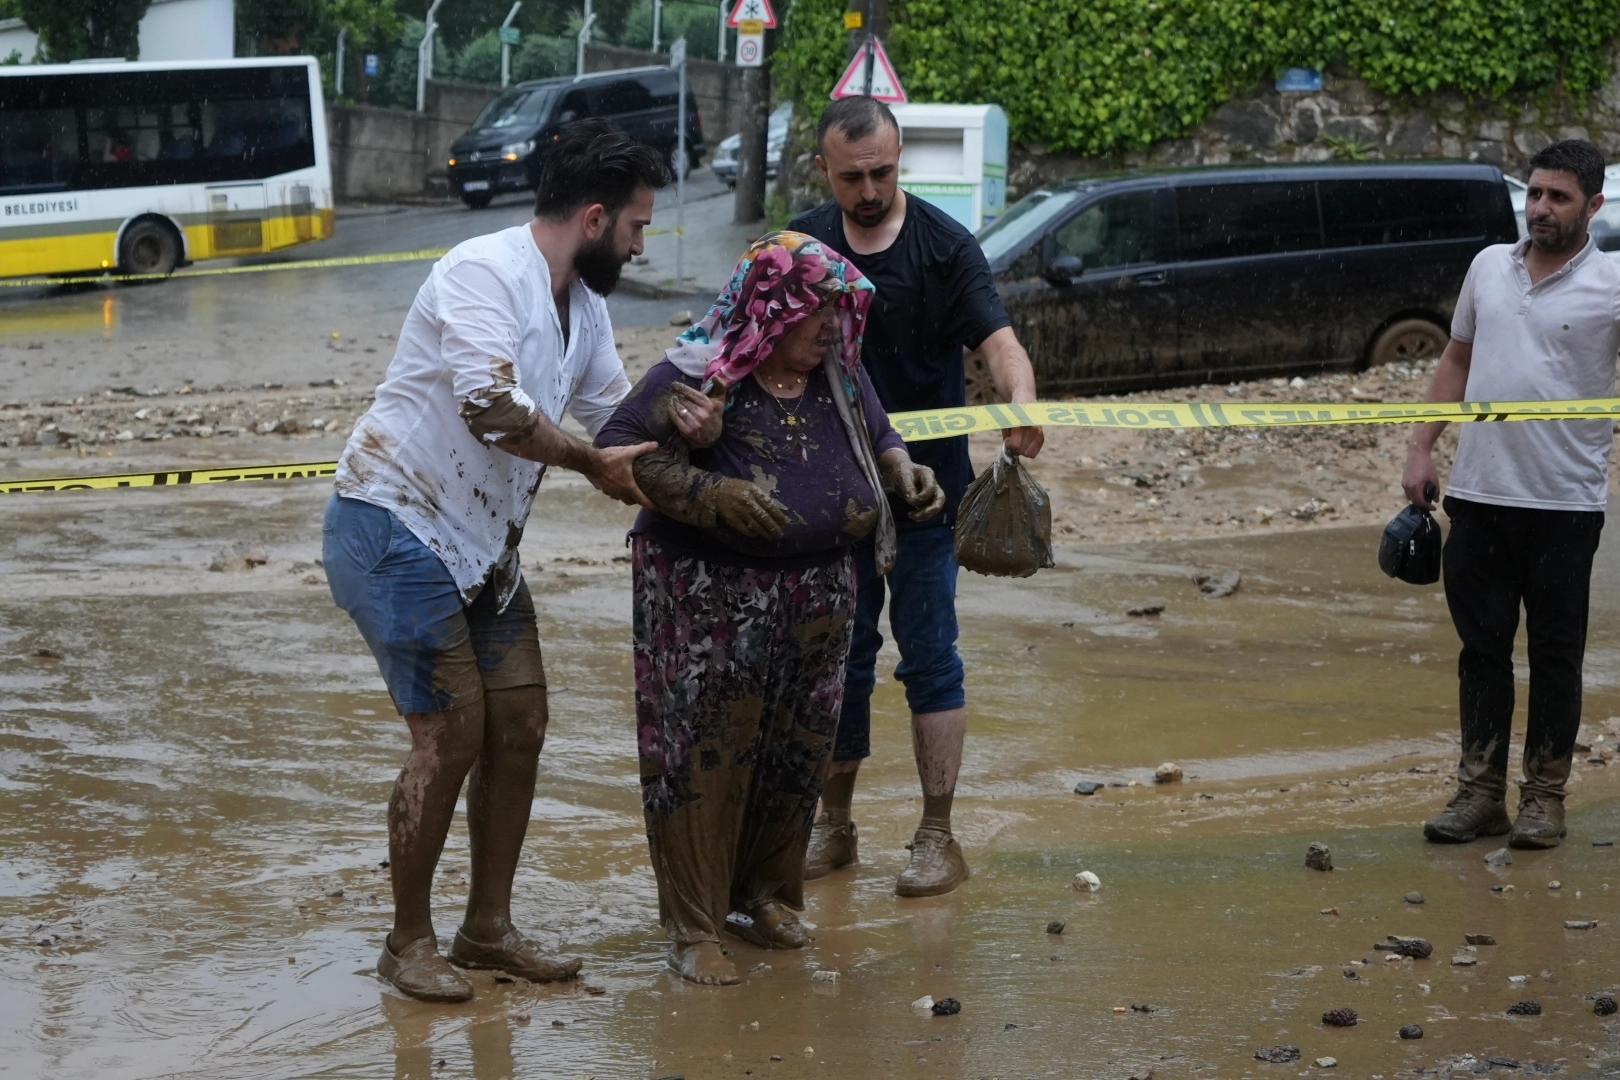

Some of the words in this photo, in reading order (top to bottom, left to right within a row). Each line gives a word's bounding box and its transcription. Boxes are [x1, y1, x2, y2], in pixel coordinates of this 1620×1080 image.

[744, 46, 755, 56] 30
[849, 84, 891, 96] YAAŞ
[4, 197, 79, 216] BELEDİYESİ
